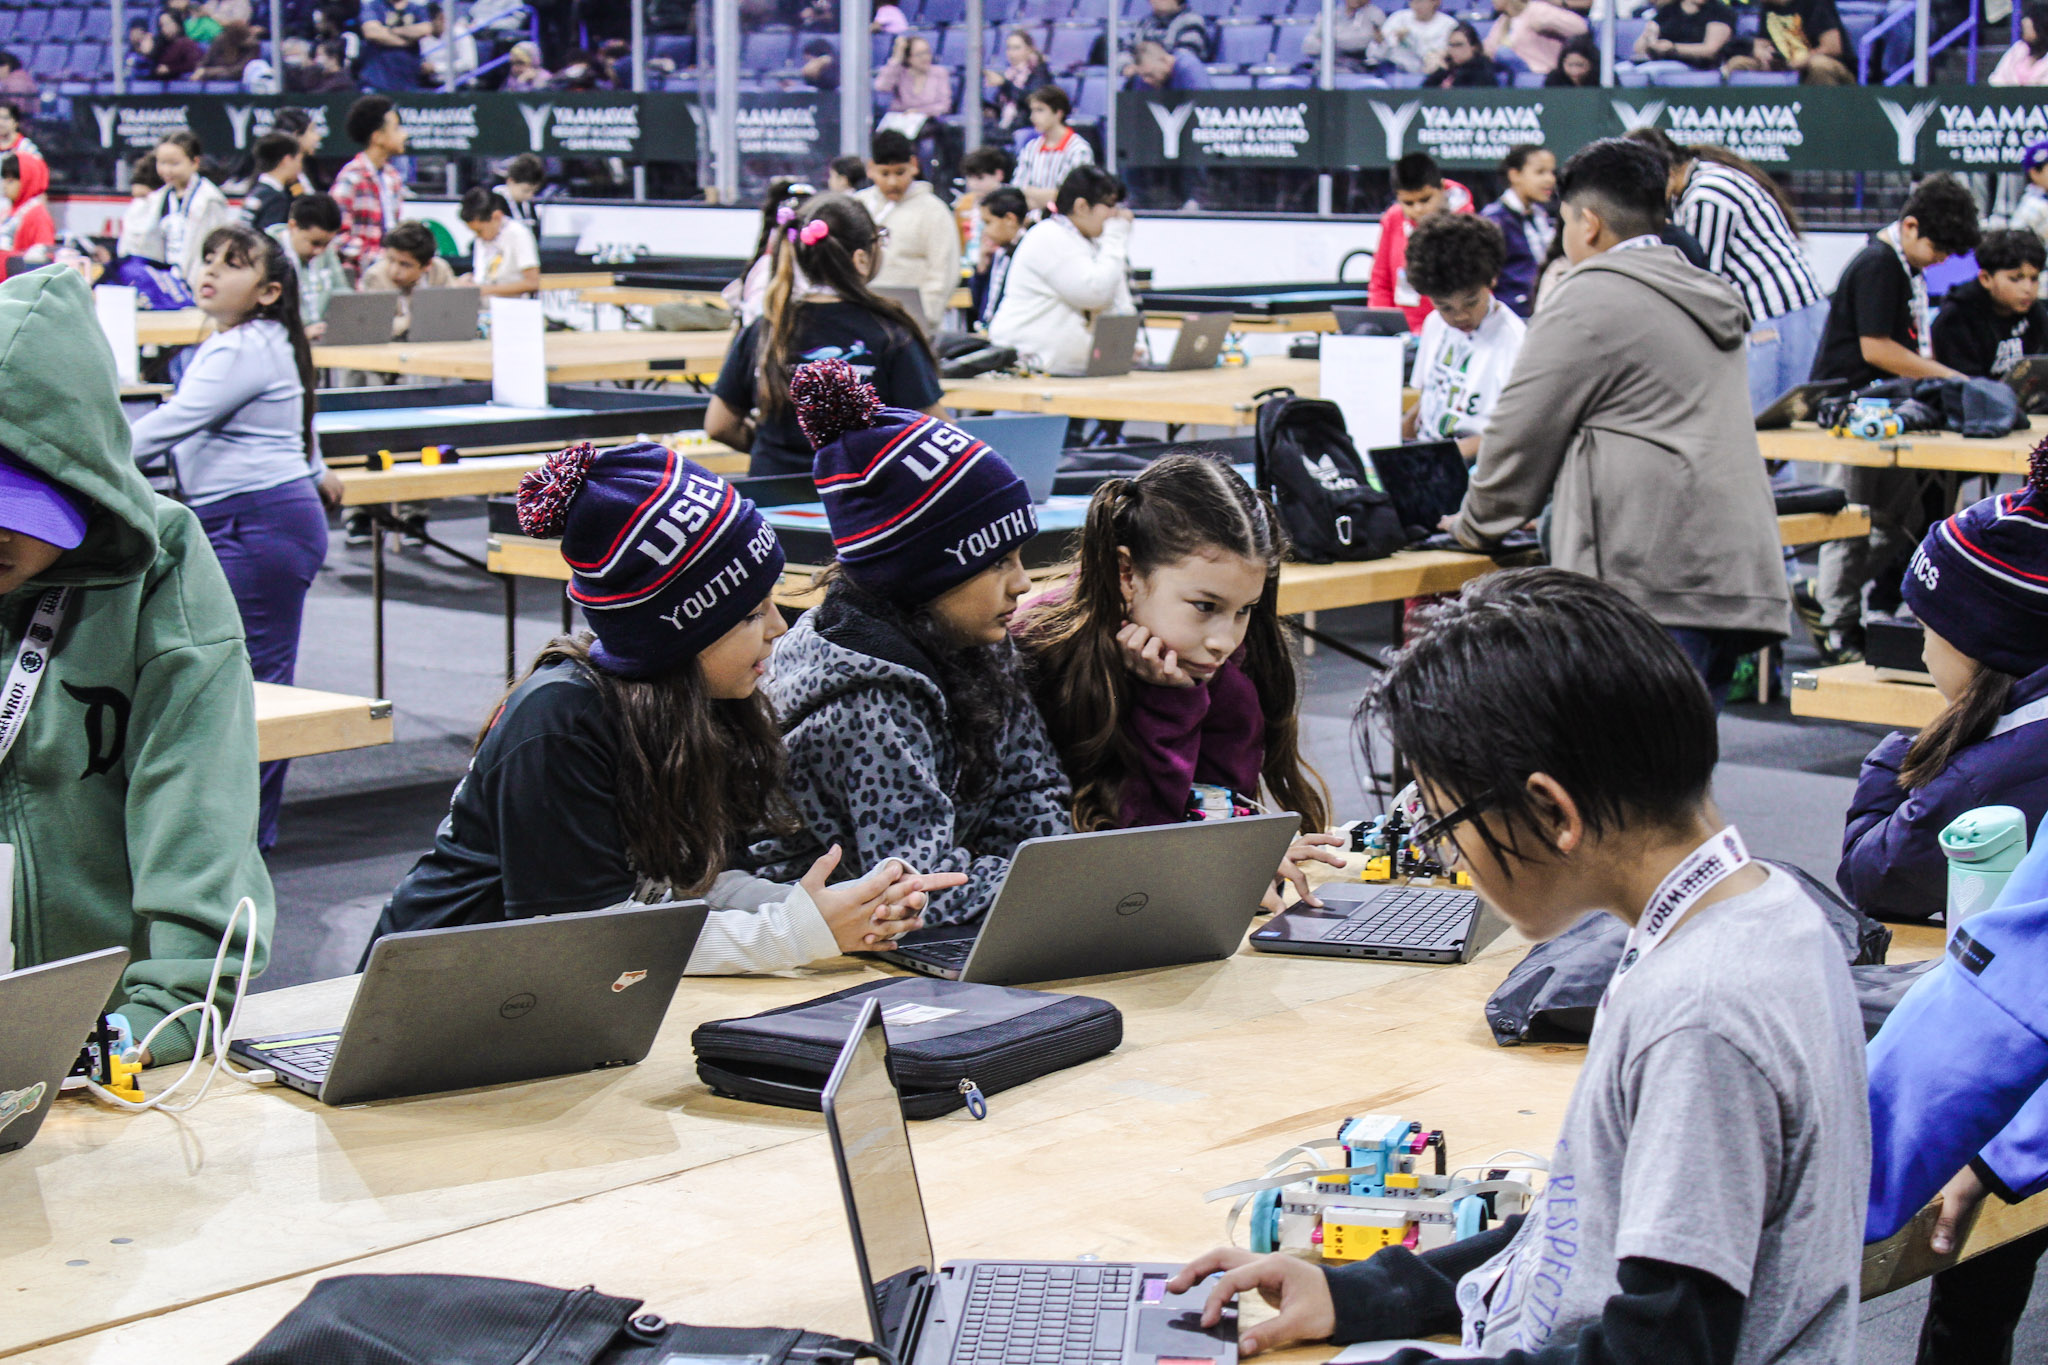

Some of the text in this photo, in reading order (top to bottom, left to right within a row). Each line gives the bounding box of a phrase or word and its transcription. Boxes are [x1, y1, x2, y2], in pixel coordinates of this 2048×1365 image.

[1940, 104, 2048, 130] YAAMA
[637, 474, 724, 566] USEL
[944, 509, 1028, 565] YOUTH
[660, 557, 749, 630] YOUTH
